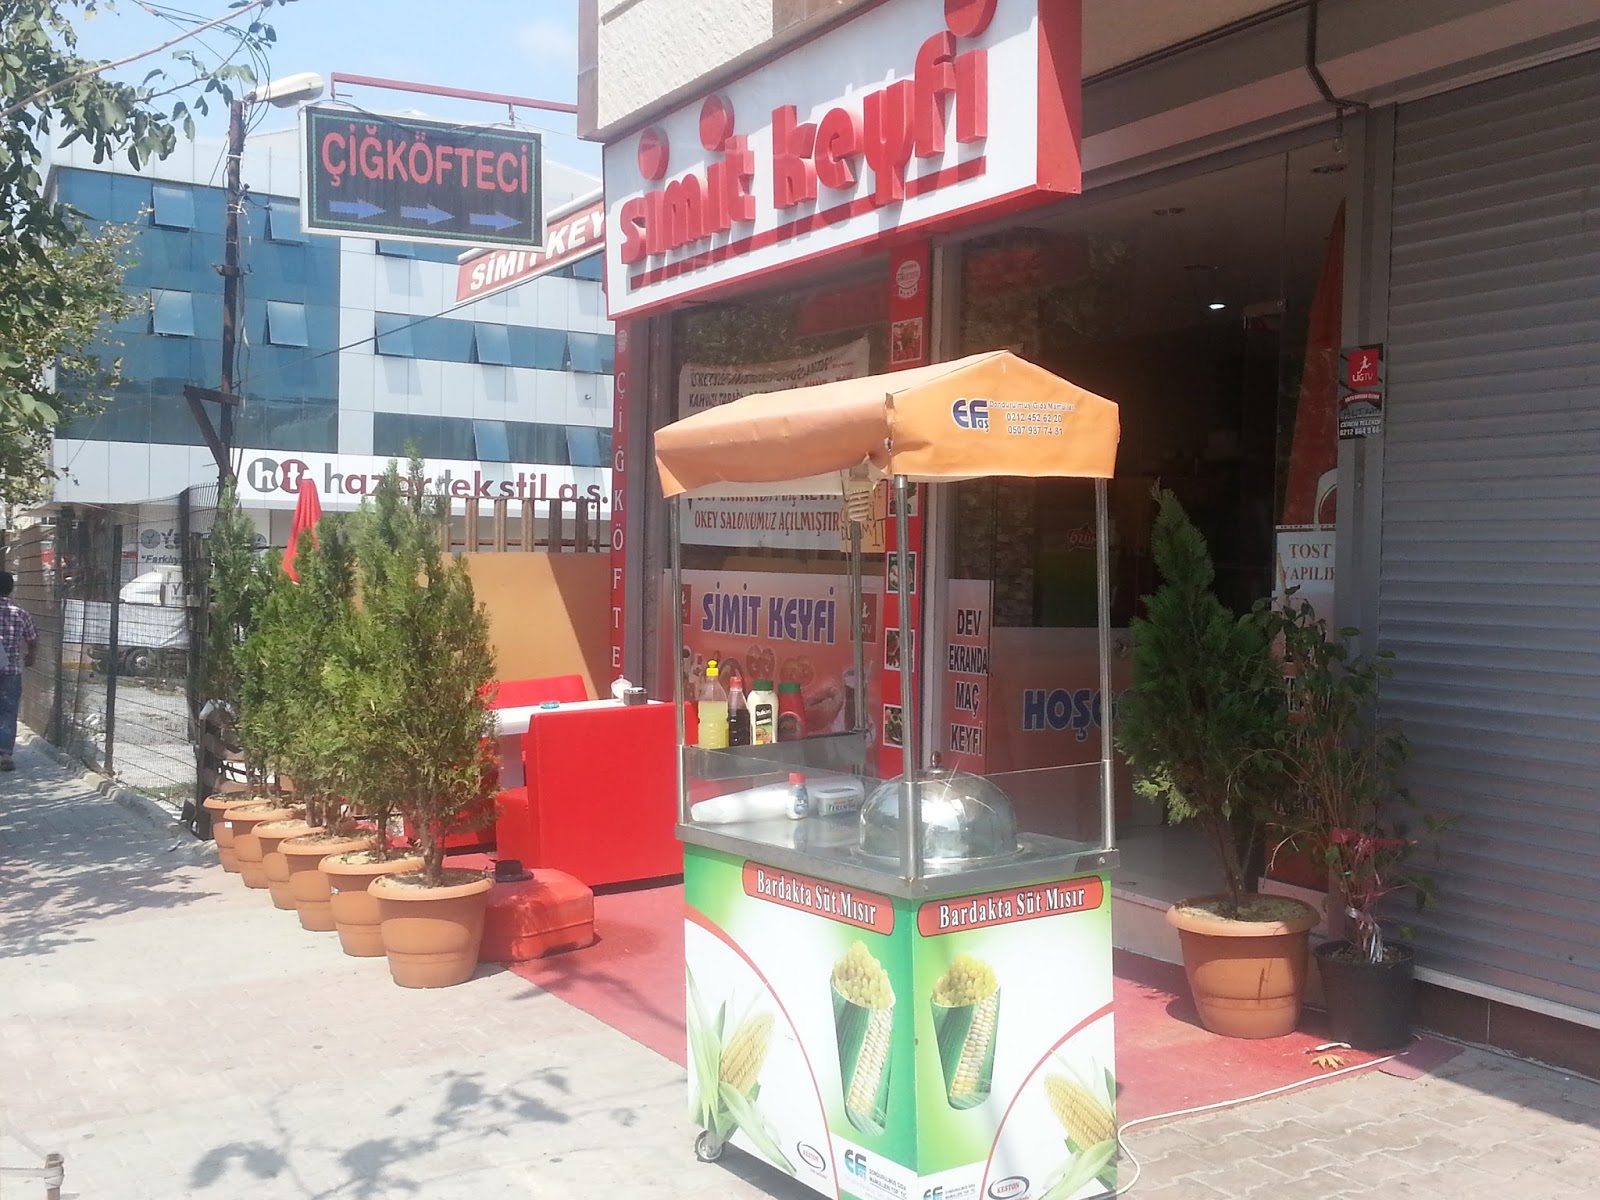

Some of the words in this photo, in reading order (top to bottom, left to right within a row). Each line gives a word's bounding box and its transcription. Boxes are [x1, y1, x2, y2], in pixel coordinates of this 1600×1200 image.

[620, 94, 755, 265] simit
[772, 0, 997, 206] keyfi
[322, 124, 528, 194] ÇİĞKÖFTECİ
[1006, 412, 1026, 422] 0212
[1027, 413, 1041, 422] 452
[1053, 414, 1063, 423] 20
[1007, 425, 1026, 435] 0507
[693, 510, 719, 529] OKEY
[720, 511, 776, 531] SALONUMUZ
[1289, 543, 1332, 559] TOST
[702, 581, 761, 637] SİMİT
[768, 586, 836, 645] KEYFİ
[957, 609, 982, 637] DEV
[948, 644, 988, 676] EKRANDA
[955, 681, 979, 718] MAÇ
[950, 721, 983, 756] KEYFİ
[757, 868, 812, 907] Bardakta
[815, 885, 837, 914] Süt
[839, 891, 877, 926] Mısır
[939, 896, 1012, 929] Bardakta
[1016, 891, 1042, 916] Süt
[1045, 887, 1086, 911] Mısır
[996, 1181, 1021, 1195] KESTON
